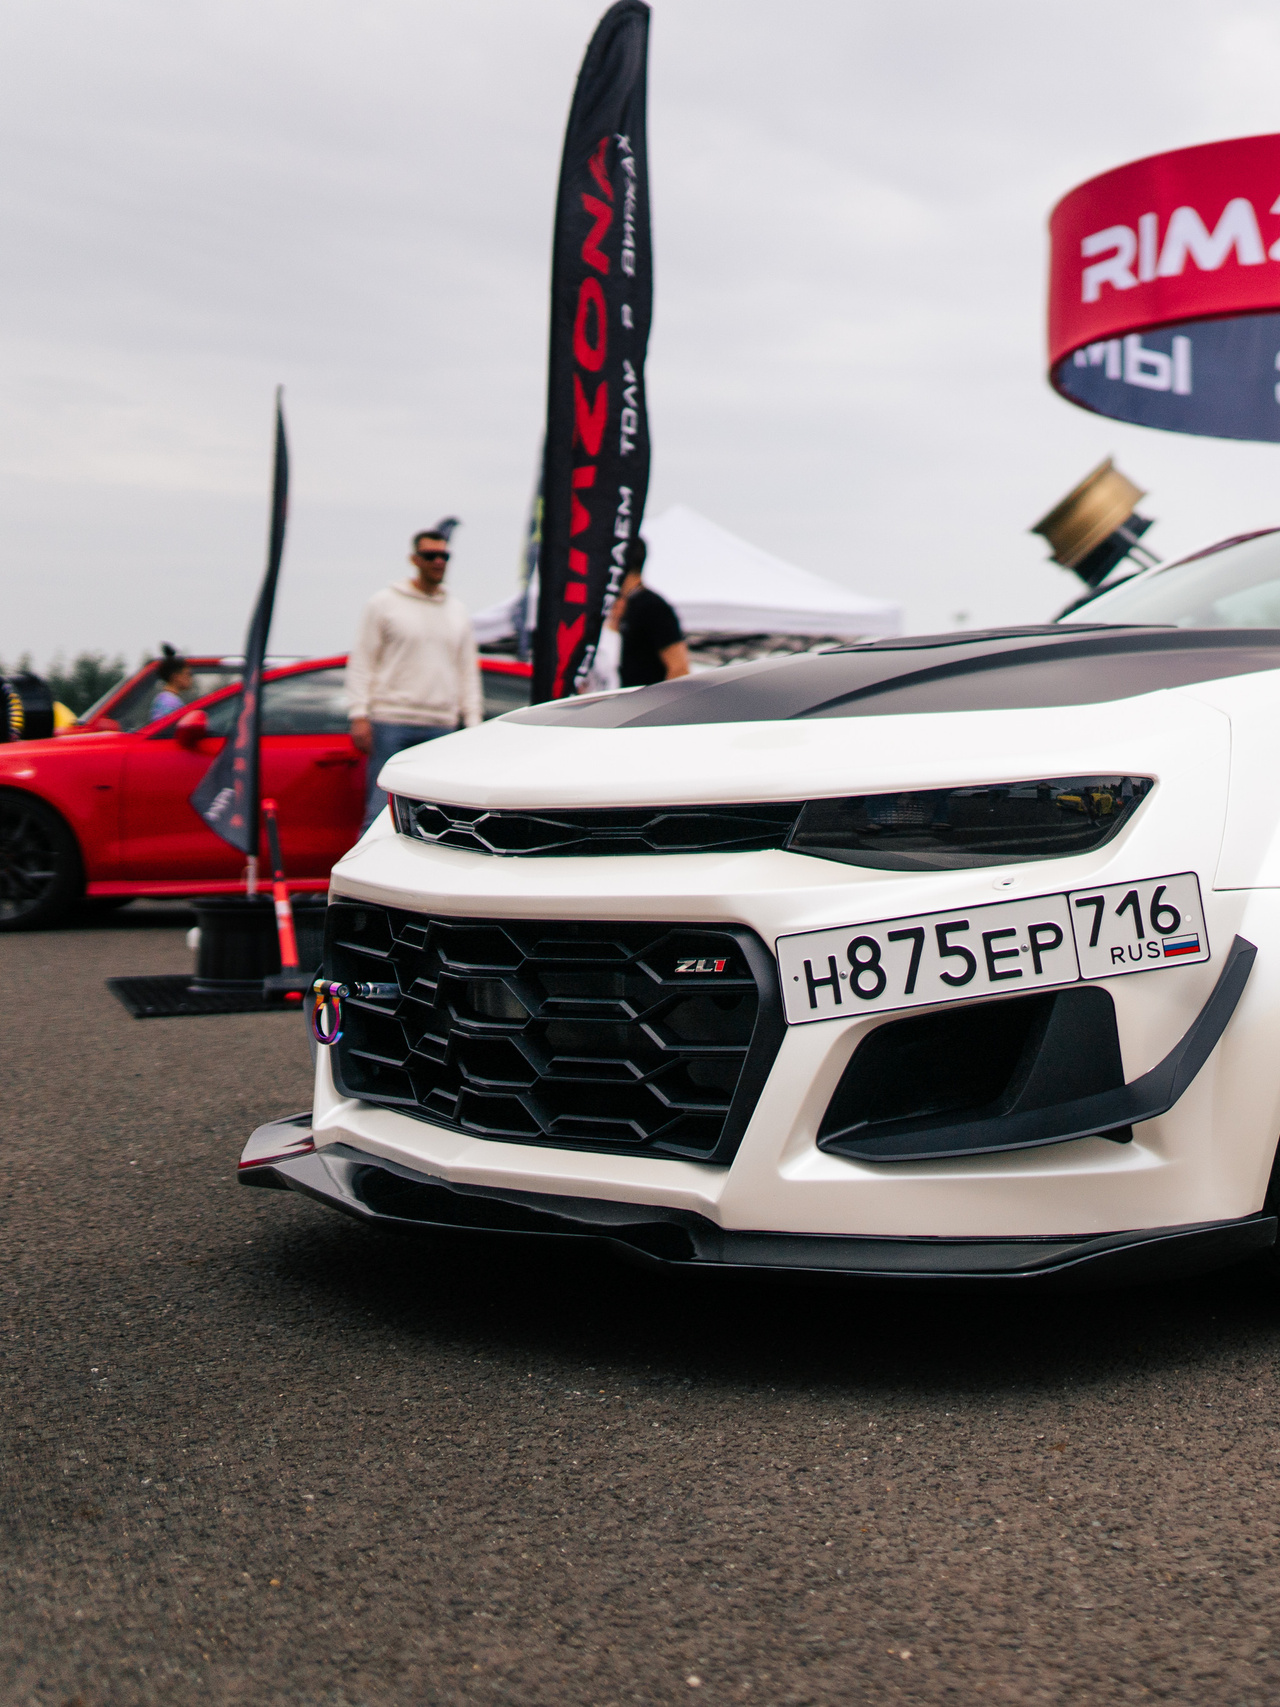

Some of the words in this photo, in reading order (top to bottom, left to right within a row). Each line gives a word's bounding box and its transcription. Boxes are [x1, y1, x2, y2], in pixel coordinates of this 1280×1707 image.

[1074, 885, 1181, 947] 716
[1111, 940, 1161, 965] RUS
[674, 959, 727, 973] ZL1
